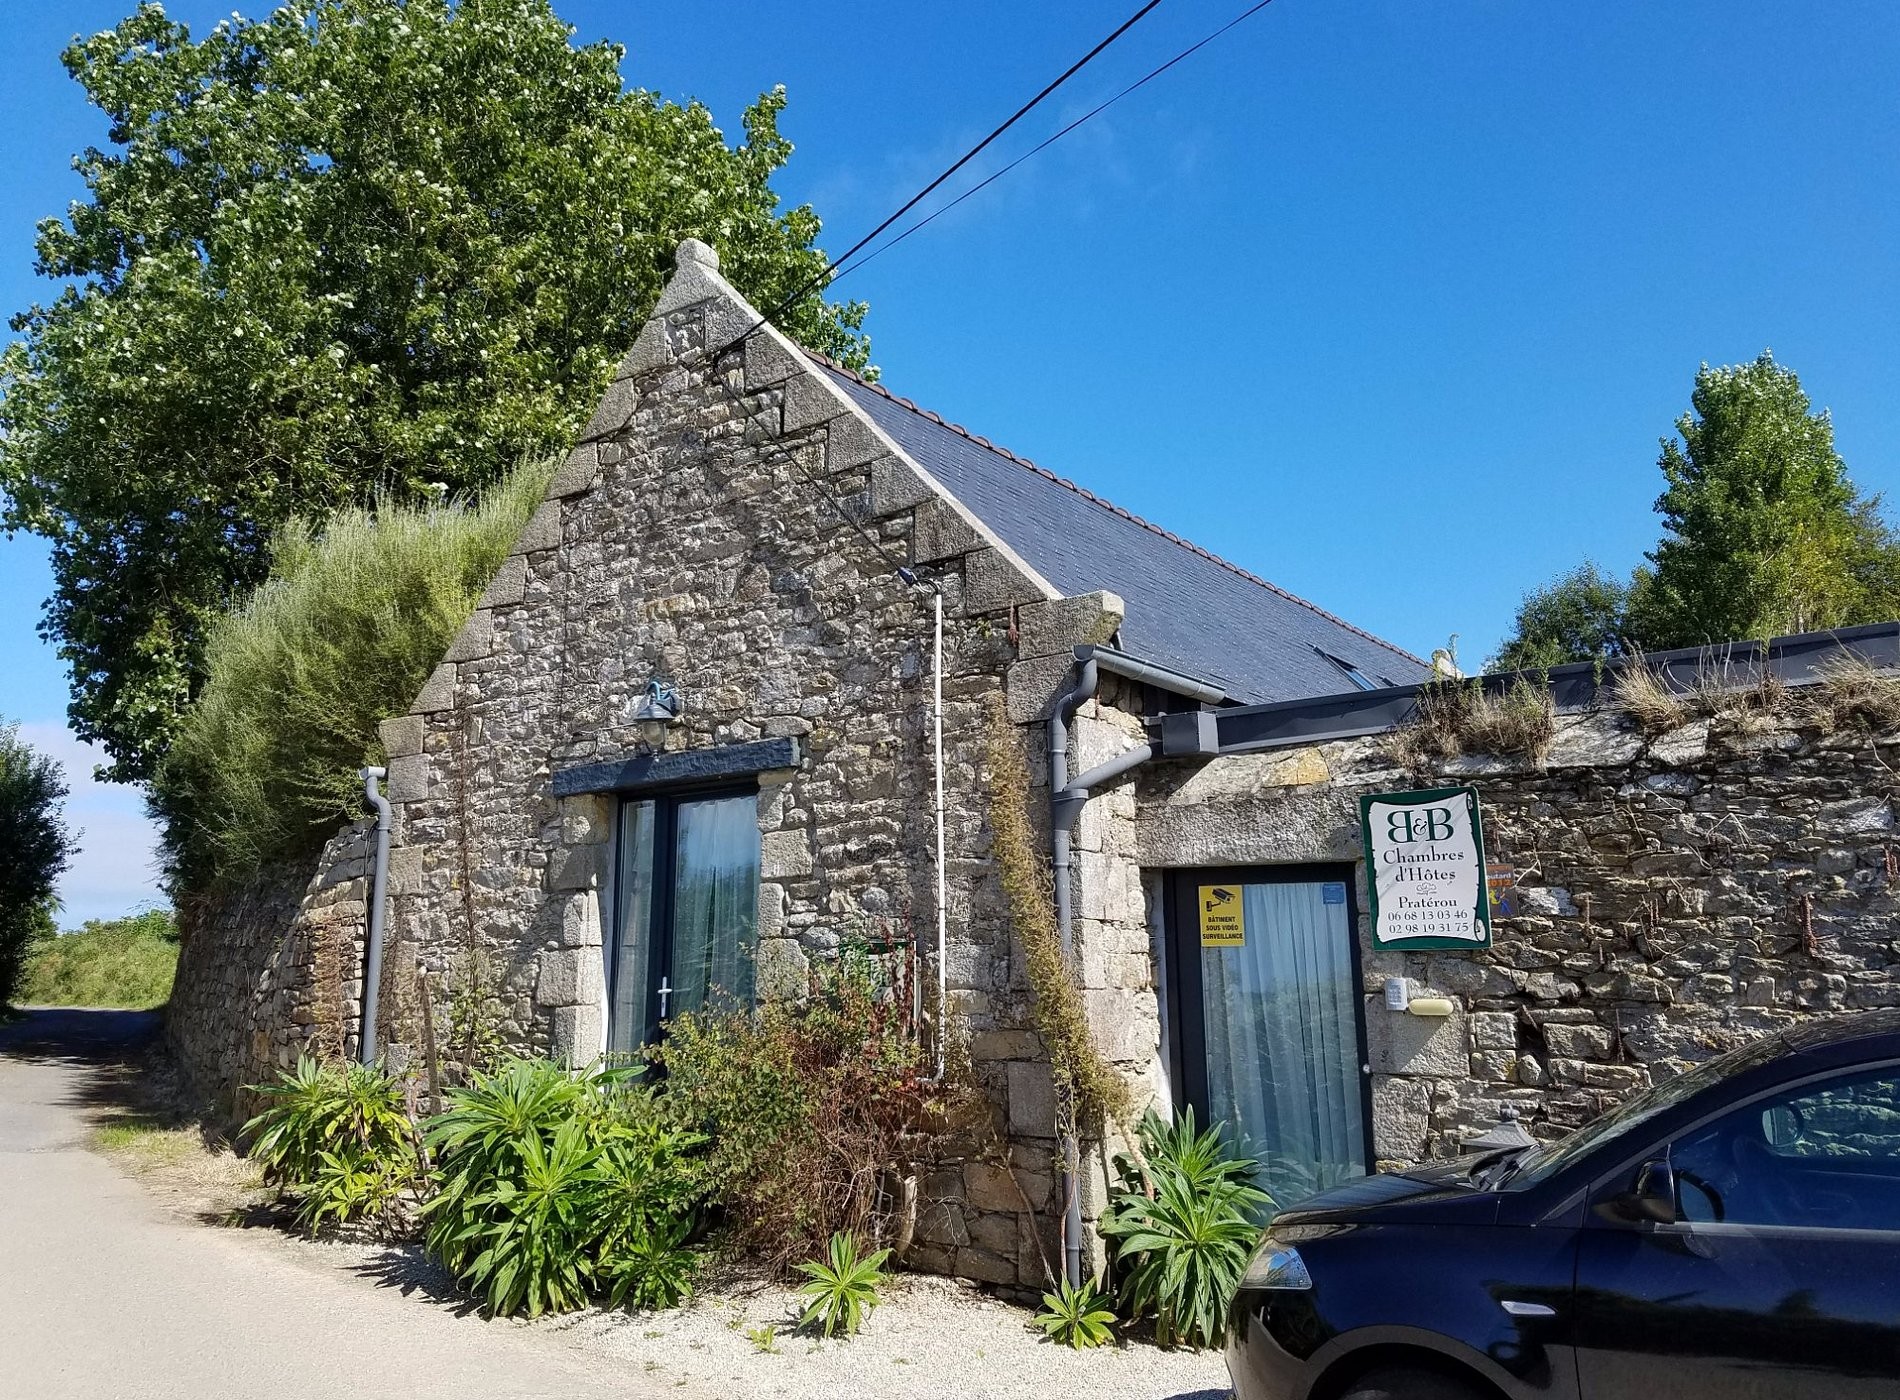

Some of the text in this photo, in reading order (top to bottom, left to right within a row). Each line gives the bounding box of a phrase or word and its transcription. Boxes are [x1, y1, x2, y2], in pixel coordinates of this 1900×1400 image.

[1383, 845, 1464, 864] Chambres
[1395, 865, 1456, 882] d'Hôtes
[1399, 896, 1457, 909] Pratérou
[1388, 909, 1468, 921] 06 68 13 03 46
[1389, 922, 1469, 934] 02 98 19 31 75
